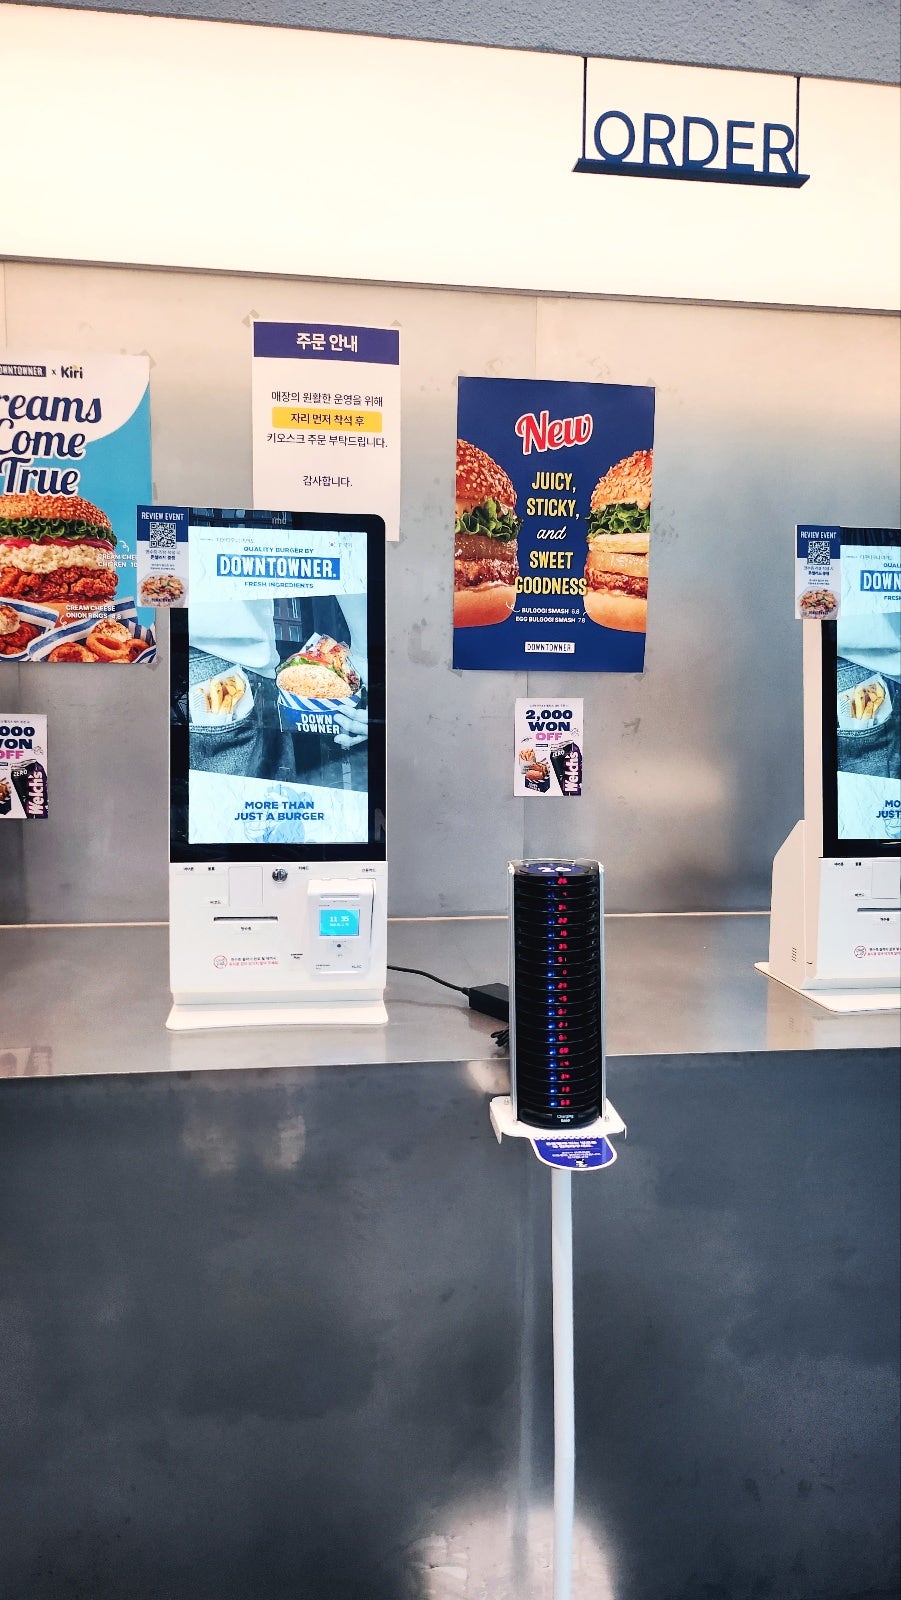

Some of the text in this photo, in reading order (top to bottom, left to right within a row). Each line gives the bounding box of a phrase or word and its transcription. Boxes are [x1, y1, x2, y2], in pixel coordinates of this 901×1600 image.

[594, 110, 795, 174] ORDER
[296, 333, 358, 352] 주문 안내
[61, 365, 83, 379] Kiri
[271, 391, 383, 407] 매장의 원활한 운영을 위해
[291, 413, 365, 427] 자리 먼저 착석 후
[515, 410, 593, 455] New
[267, 433, 388, 448] 키오스크 주문 부탁드립니다.
[0, 457, 78, 494] True
[302, 475, 353, 488] 감사합니다.
[531, 471, 576, 493] JUICY,
[141, 511, 185, 521] REVIEW EVENT
[526, 498, 580, 520] STICKY,
[536, 526, 567, 541] and
[800, 531, 837, 539] REVIEW EVENT
[219, 555, 337, 579] DOWNTOWNER.
[529, 551, 574, 570] SWEET
[515, 576, 588, 597] GOODNESS
[300, 713, 333, 725] DOWN
[525, 709, 573, 721] 2,000
[296, 722, 340, 735] TOWNER
[528, 721, 571, 732] WON
[535, 732, 563, 741] OFF
[0, 739, 33, 750] ON
[13, 769, 28, 777] ZERO
[564, 751, 579, 792] Welch's
[28, 771, 44, 815] Welch's
[244, 801, 315, 810] MORE THAN
[234, 812, 324, 821] JUST A BURGER
[876, 810, 901, 819] JUST
